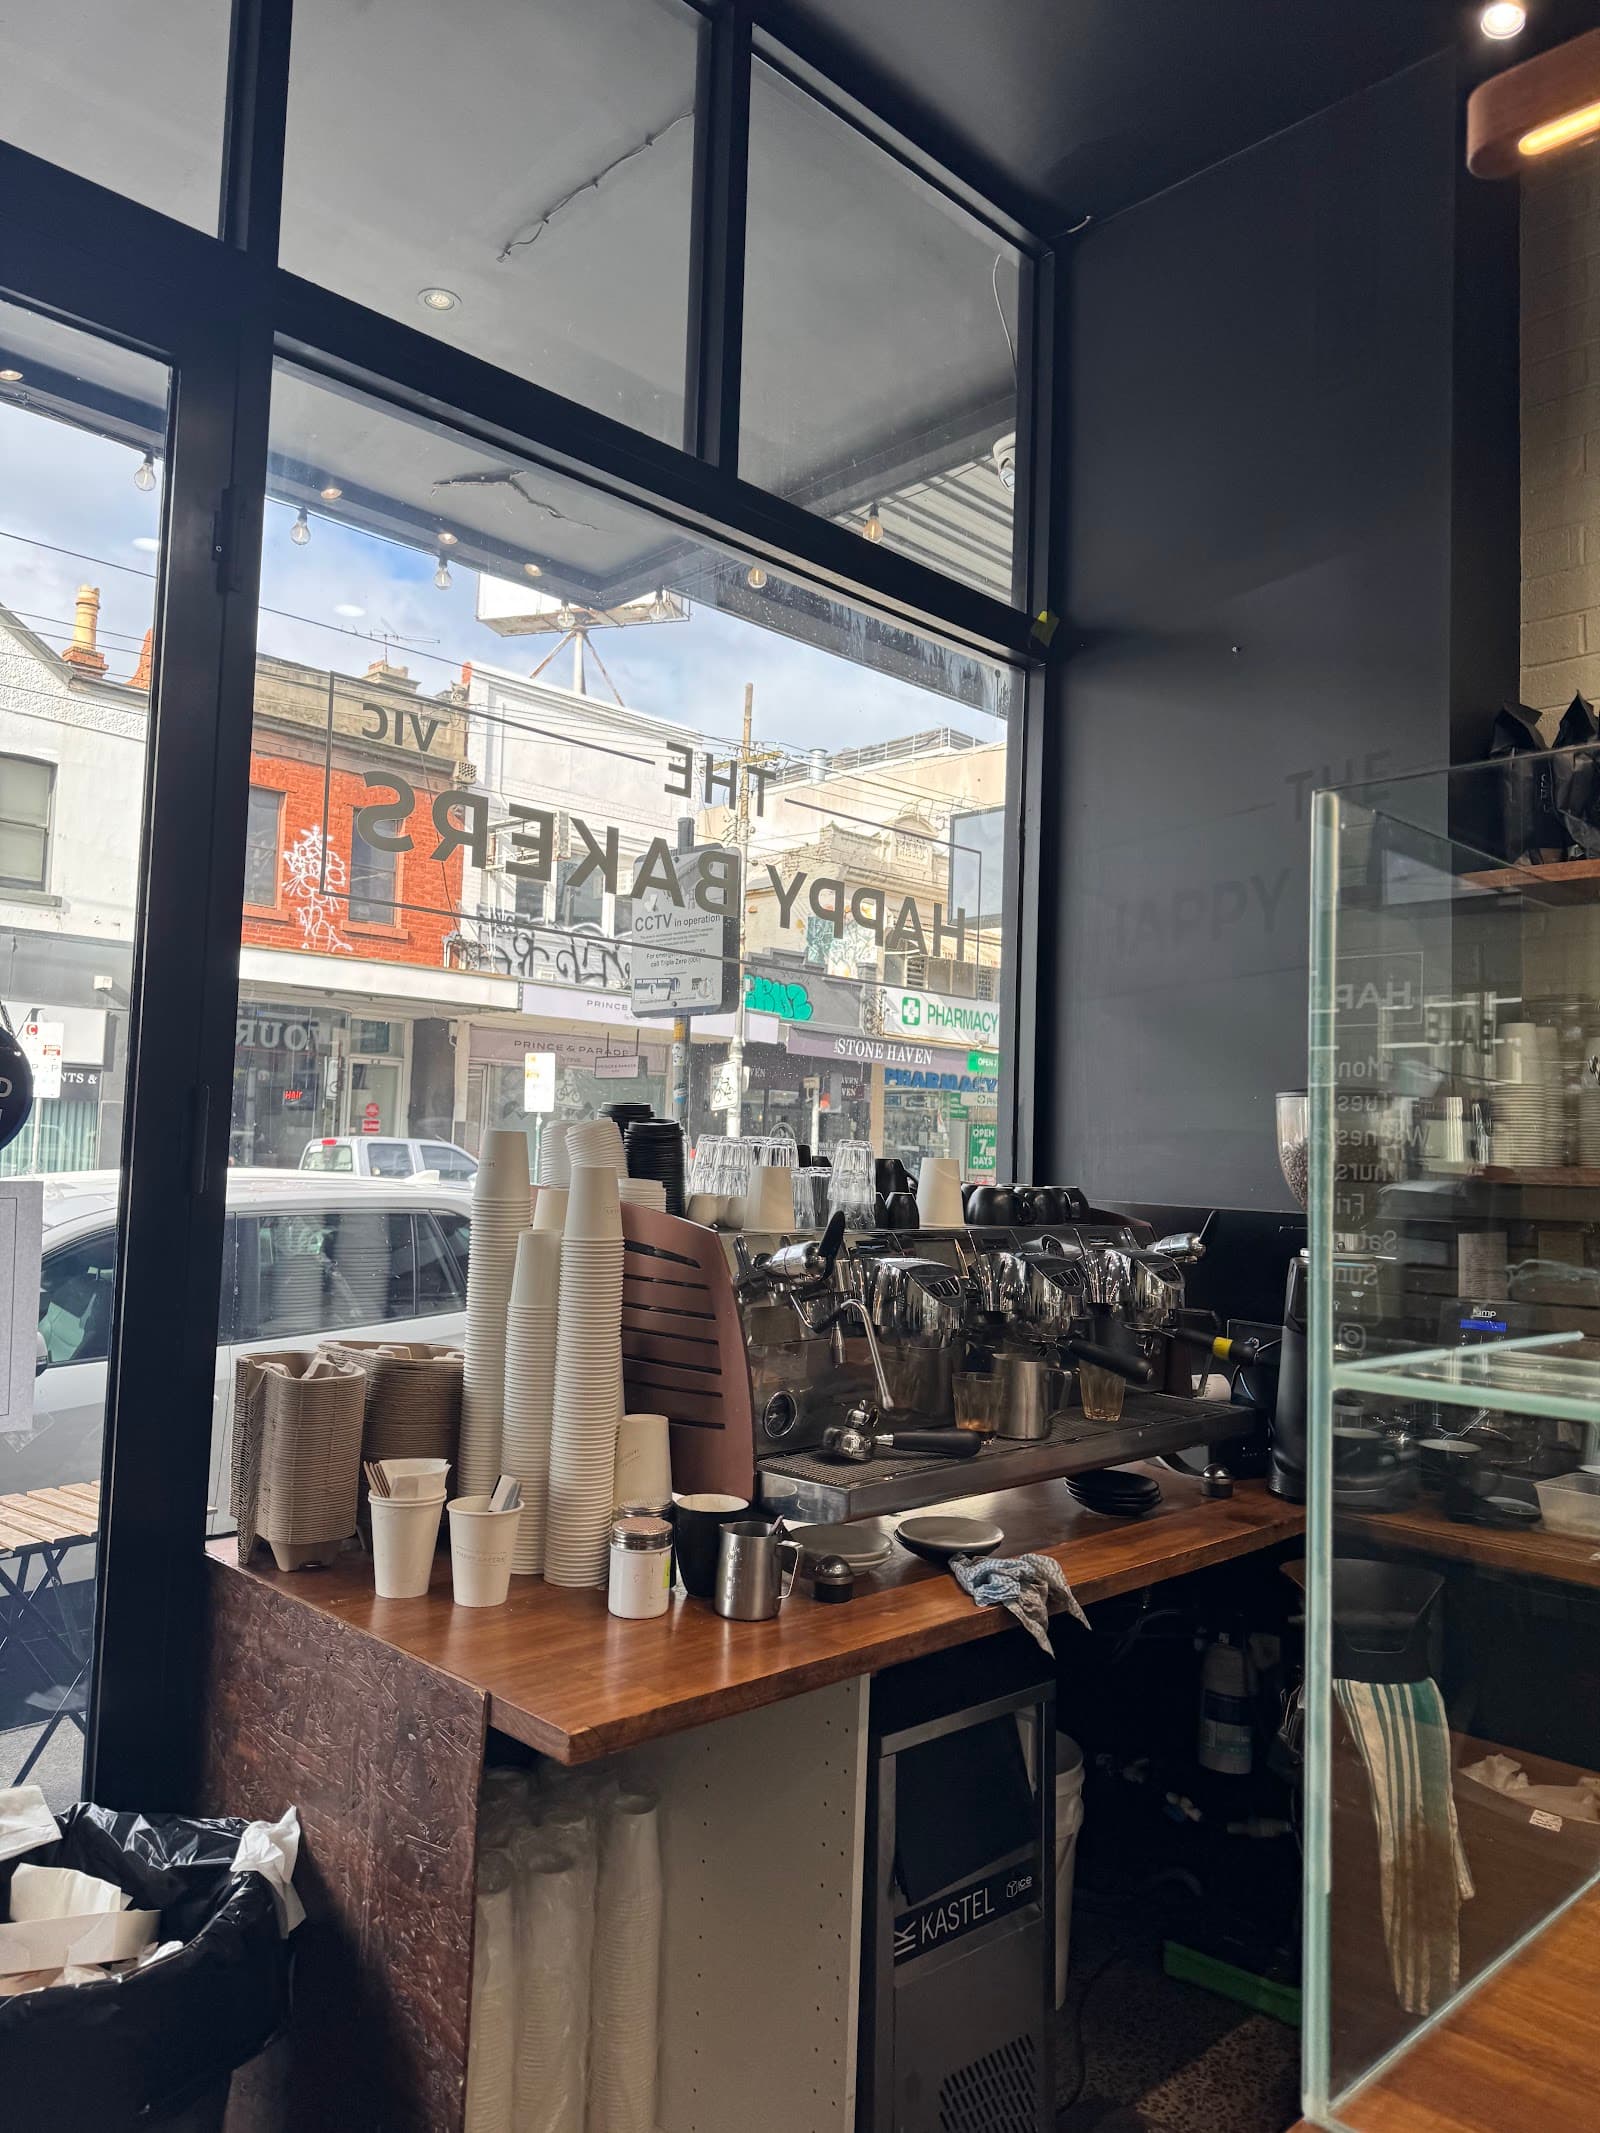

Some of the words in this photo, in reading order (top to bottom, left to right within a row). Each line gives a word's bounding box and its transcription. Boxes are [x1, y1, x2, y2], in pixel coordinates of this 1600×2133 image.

[635, 913, 673, 932] CCTV
[674, 919, 682, 928] in
[683, 913, 720, 927] operation
[586, 999, 628, 1011] PRINCE
[927, 1003, 999, 1034] PHARMACY
[514, 1039, 564, 1052] PRINCE
[566, 1043, 576, 1053] &
[578, 1046, 630, 1057] PARADE
[838, 1038, 884, 1060] STONE
[887, 1044, 933, 1066] HAVEN
[977, 1054, 993, 1066] OPEN
[884, 1067, 998, 1093] PHARMACY
[972, 1128, 995, 1138] OPEN
[978, 1138, 988, 1156] 7
[972, 1156, 993, 1167] DAYS
[921, 1887, 996, 1945] KASTEL
